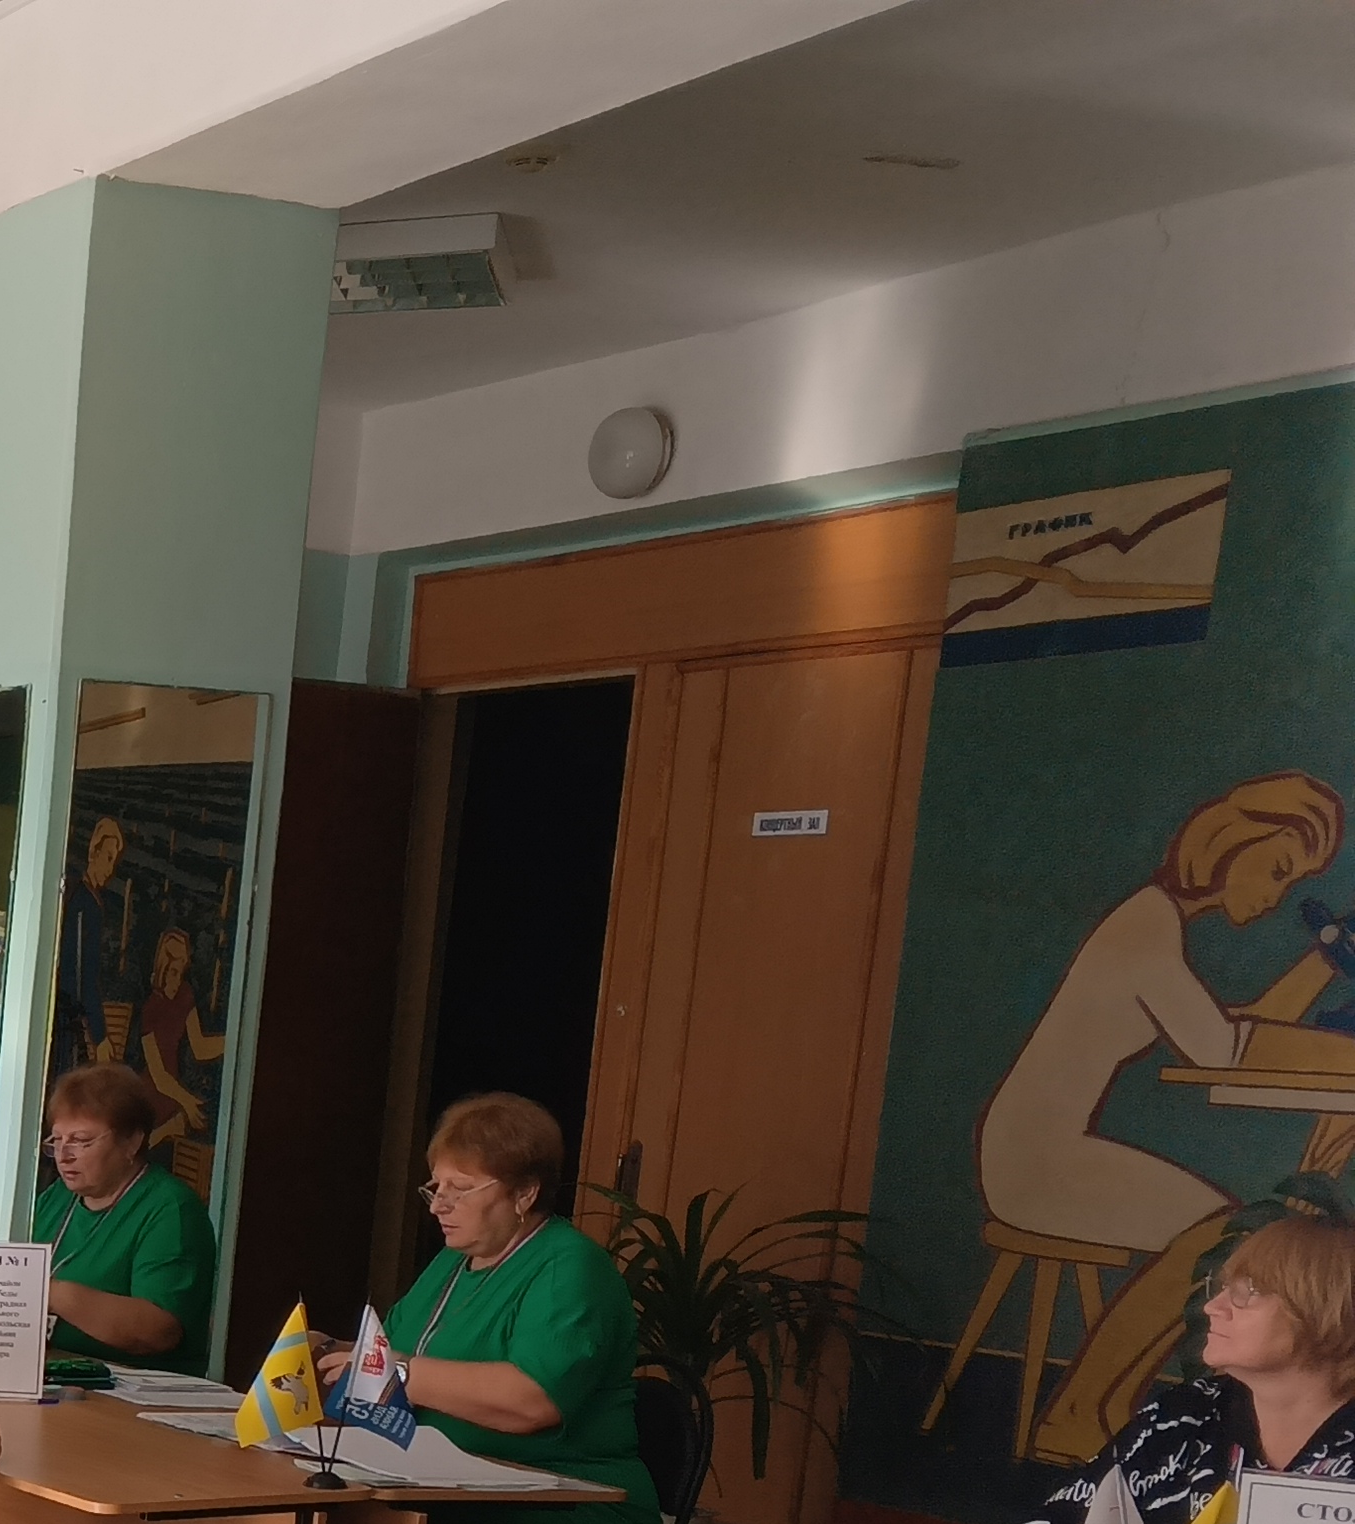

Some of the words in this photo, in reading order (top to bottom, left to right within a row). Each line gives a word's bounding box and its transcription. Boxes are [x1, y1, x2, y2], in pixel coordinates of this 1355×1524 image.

[1009, 512, 1093, 540] ГРАФИК
[6, 1256, 19, 1267] №
[1297, 1503, 1355, 1523] СТО
